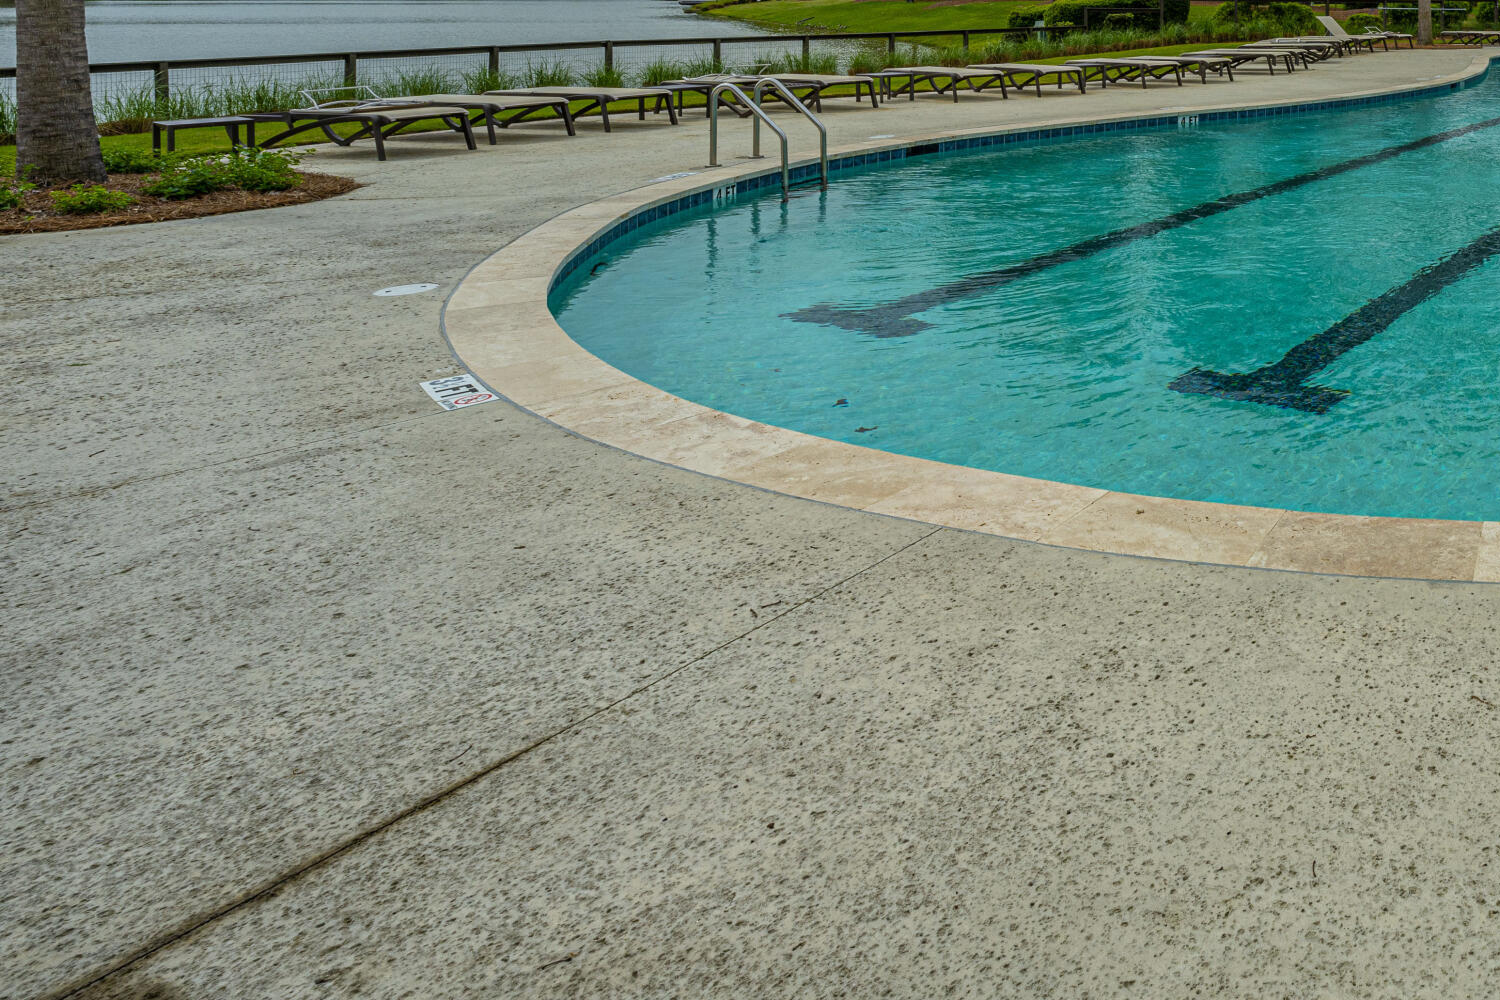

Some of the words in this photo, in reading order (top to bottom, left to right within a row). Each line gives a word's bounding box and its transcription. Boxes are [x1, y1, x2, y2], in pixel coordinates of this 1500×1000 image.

[716, 188, 722, 199] 4
[725, 184, 736, 197] FT
[434, 383, 480, 398] FT
